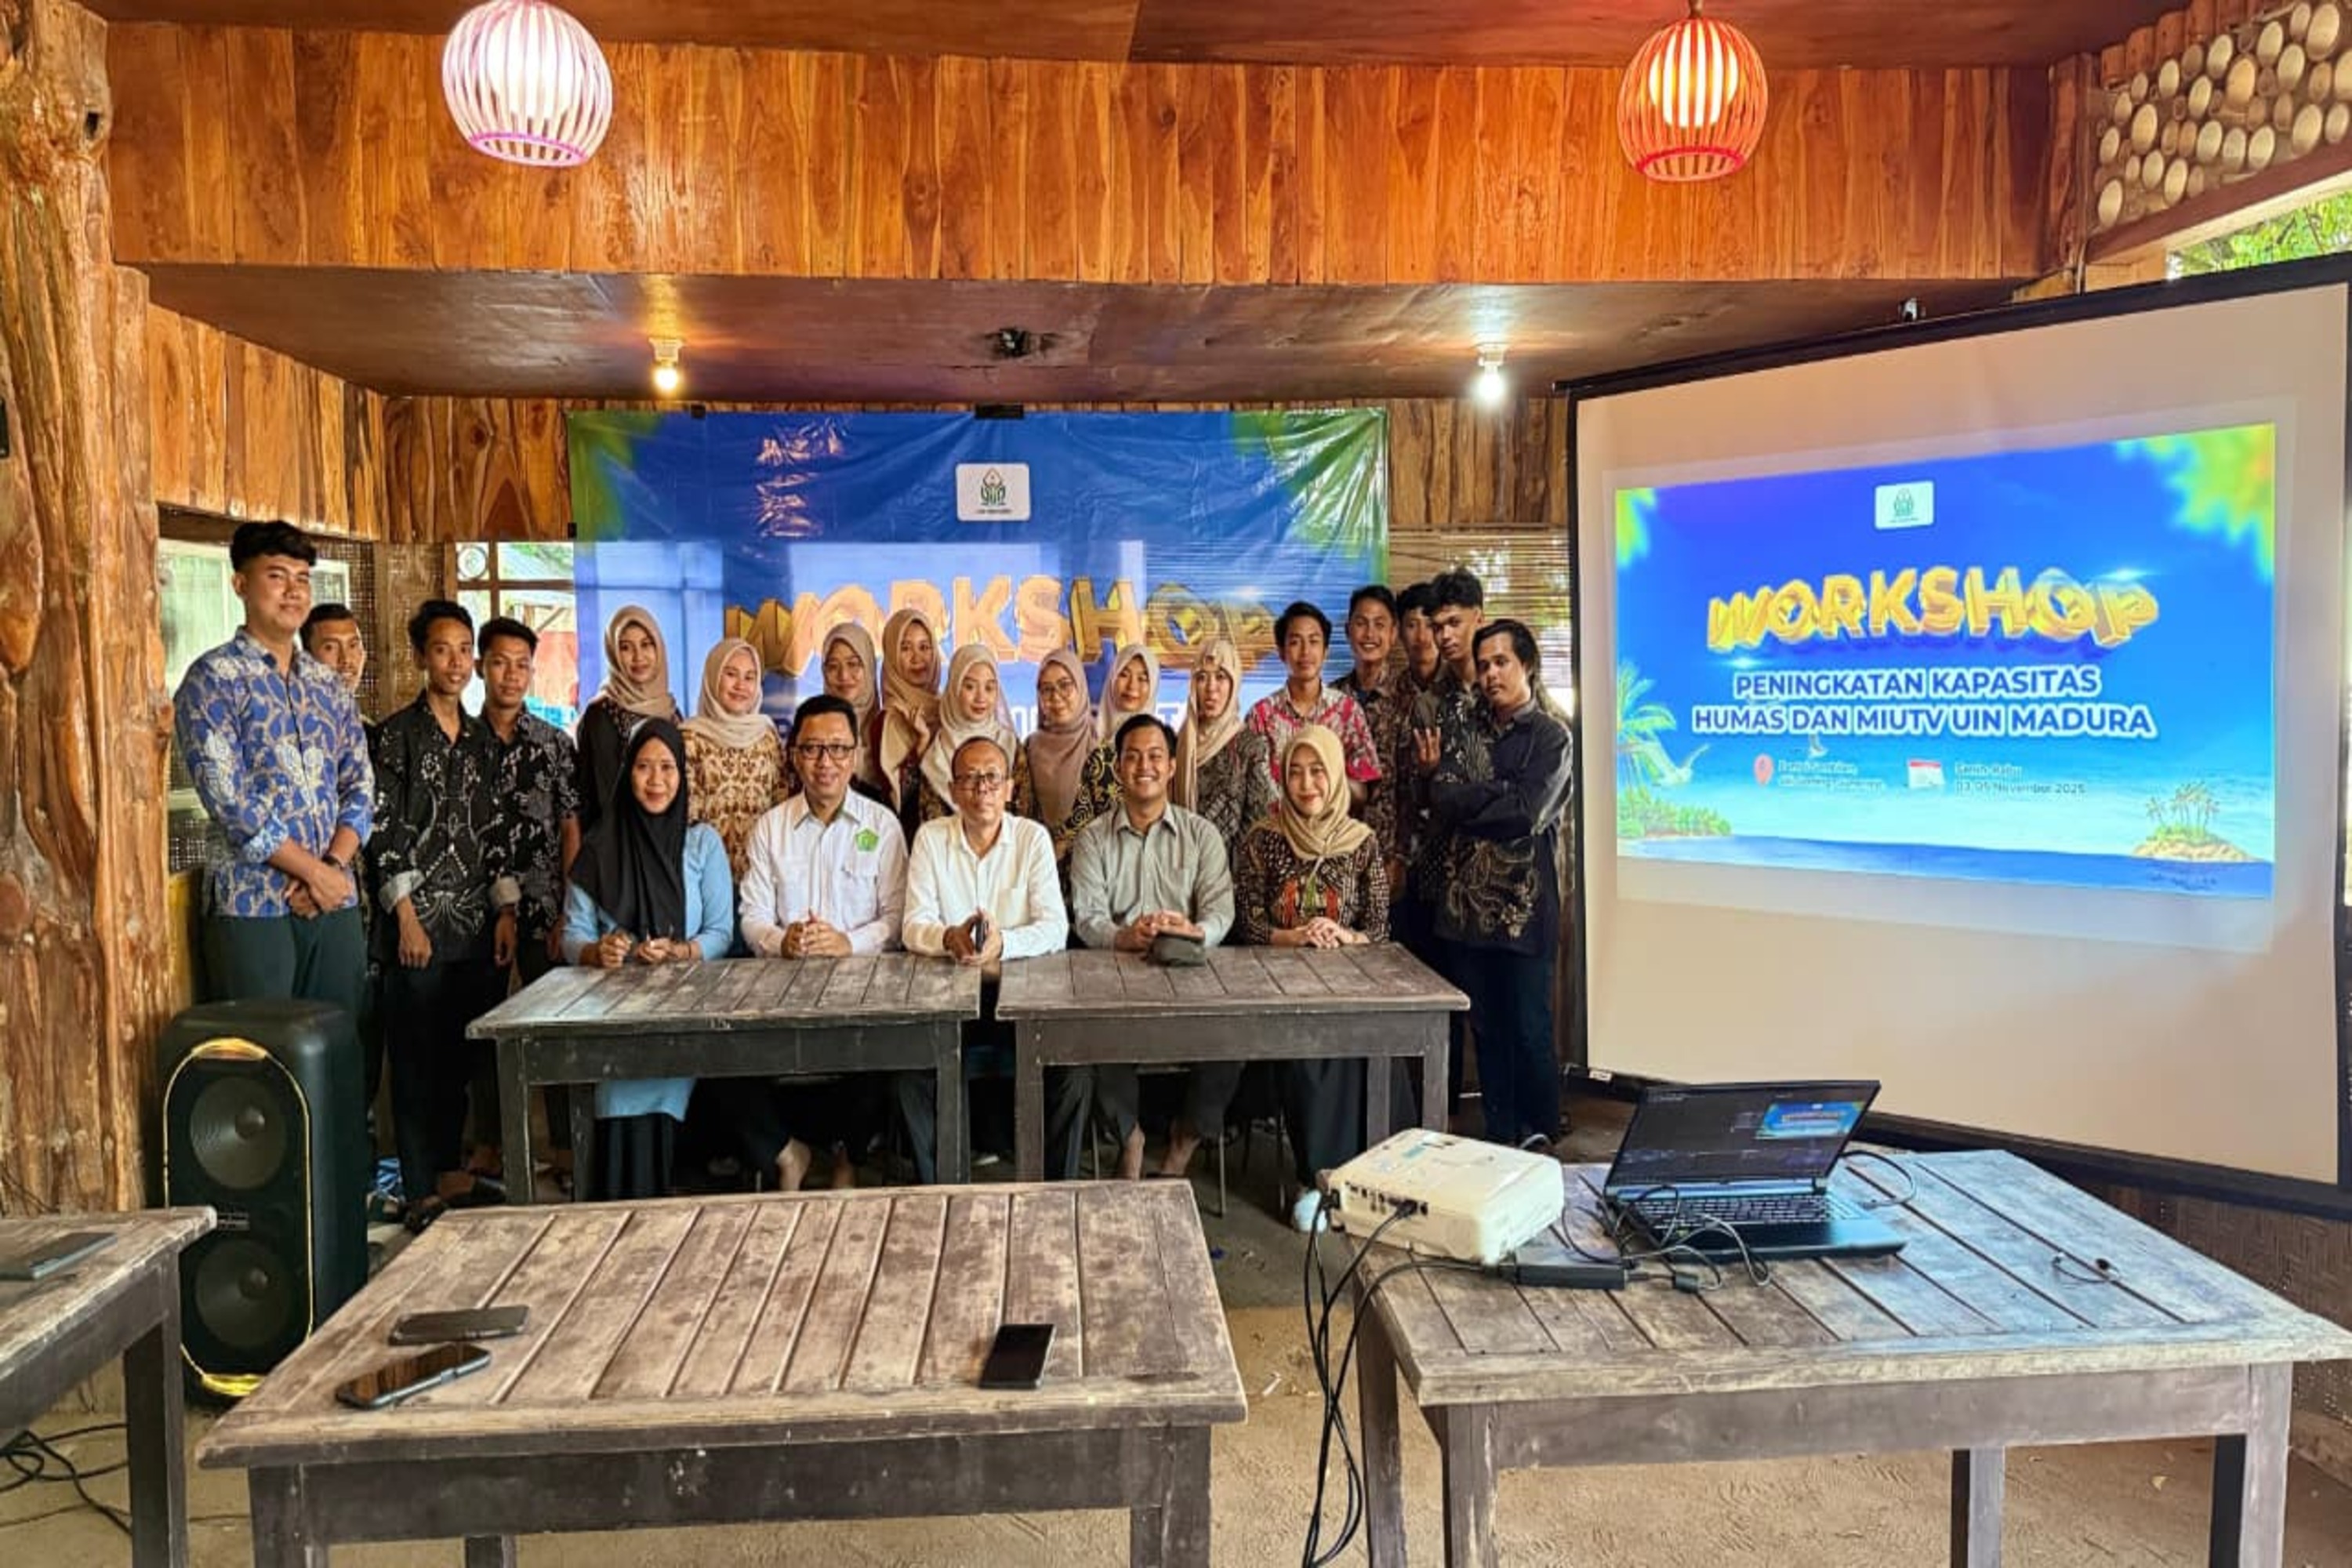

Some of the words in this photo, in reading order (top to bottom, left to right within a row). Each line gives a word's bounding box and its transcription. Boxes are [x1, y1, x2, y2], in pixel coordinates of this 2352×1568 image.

[1708, 566, 2158, 652] WORKSHOP
[1733, 670, 1925, 699] PENINGKATAN
[1929, 665, 2100, 697] KAPASITAS
[1693, 705, 1786, 733] HUMAS
[1791, 705, 1849, 734] DAN
[1854, 705, 1946, 735] MIUTV
[1950, 706, 2003, 735] UIN
[2009, 705, 2158, 738] MADURA
